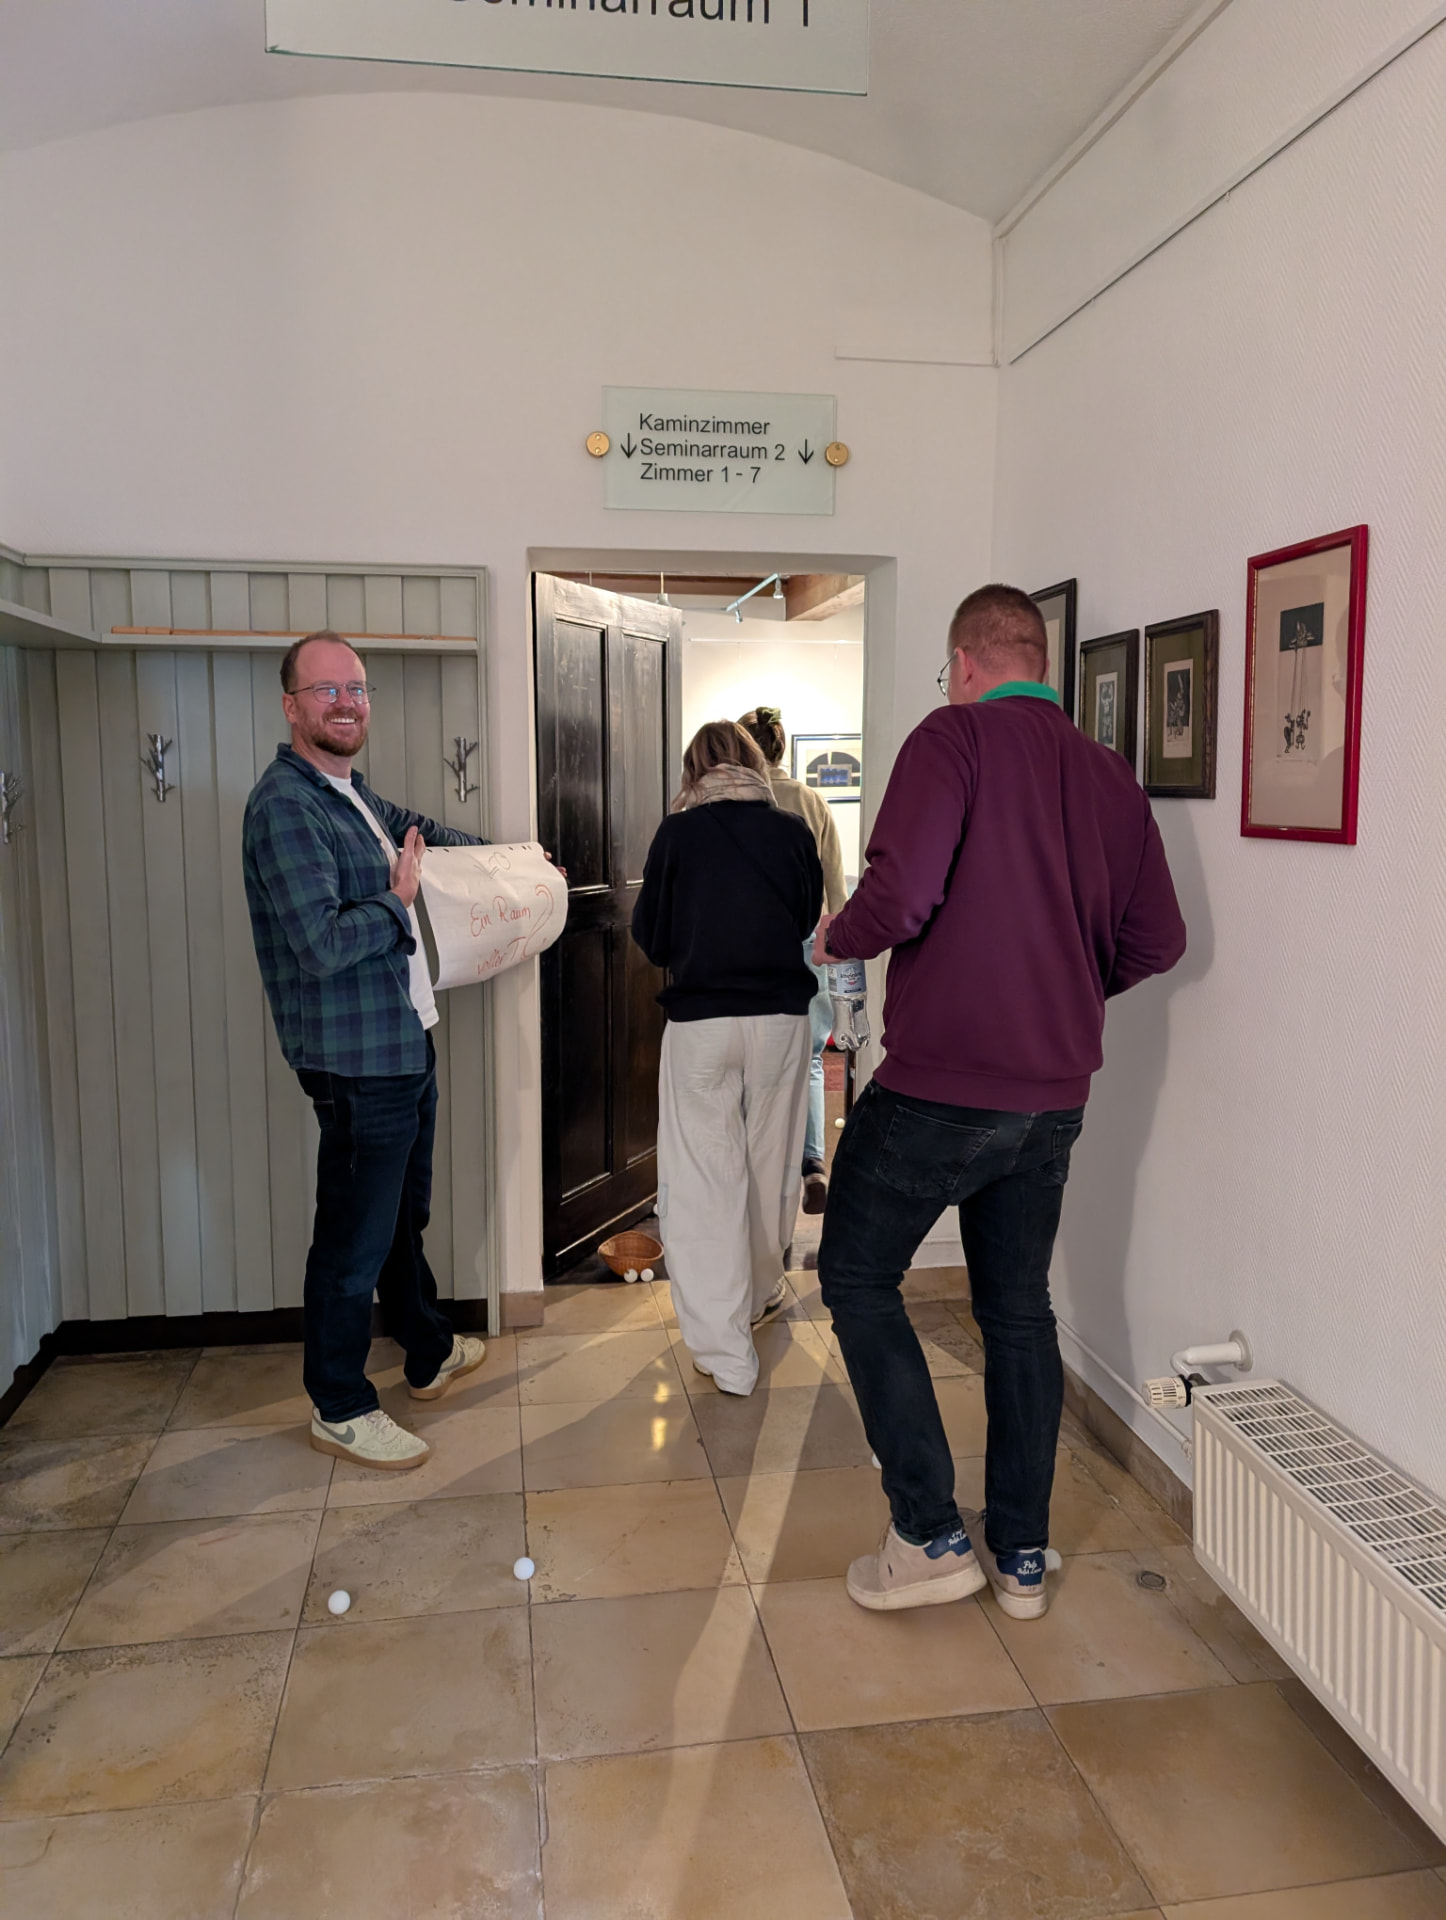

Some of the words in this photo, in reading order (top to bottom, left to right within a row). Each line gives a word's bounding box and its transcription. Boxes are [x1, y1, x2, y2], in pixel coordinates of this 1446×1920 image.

[639, 413, 770, 436] Kaminzimmer
[640, 438, 768, 460] Seminarraum
[774, 443, 785, 461] 2
[640, 463, 713, 483] Zimmer
[720, 466, 729, 483] 1
[750, 466, 761, 483] 7
[470, 902, 492, 937] Ein
[492, 895, 531, 923] Raum
